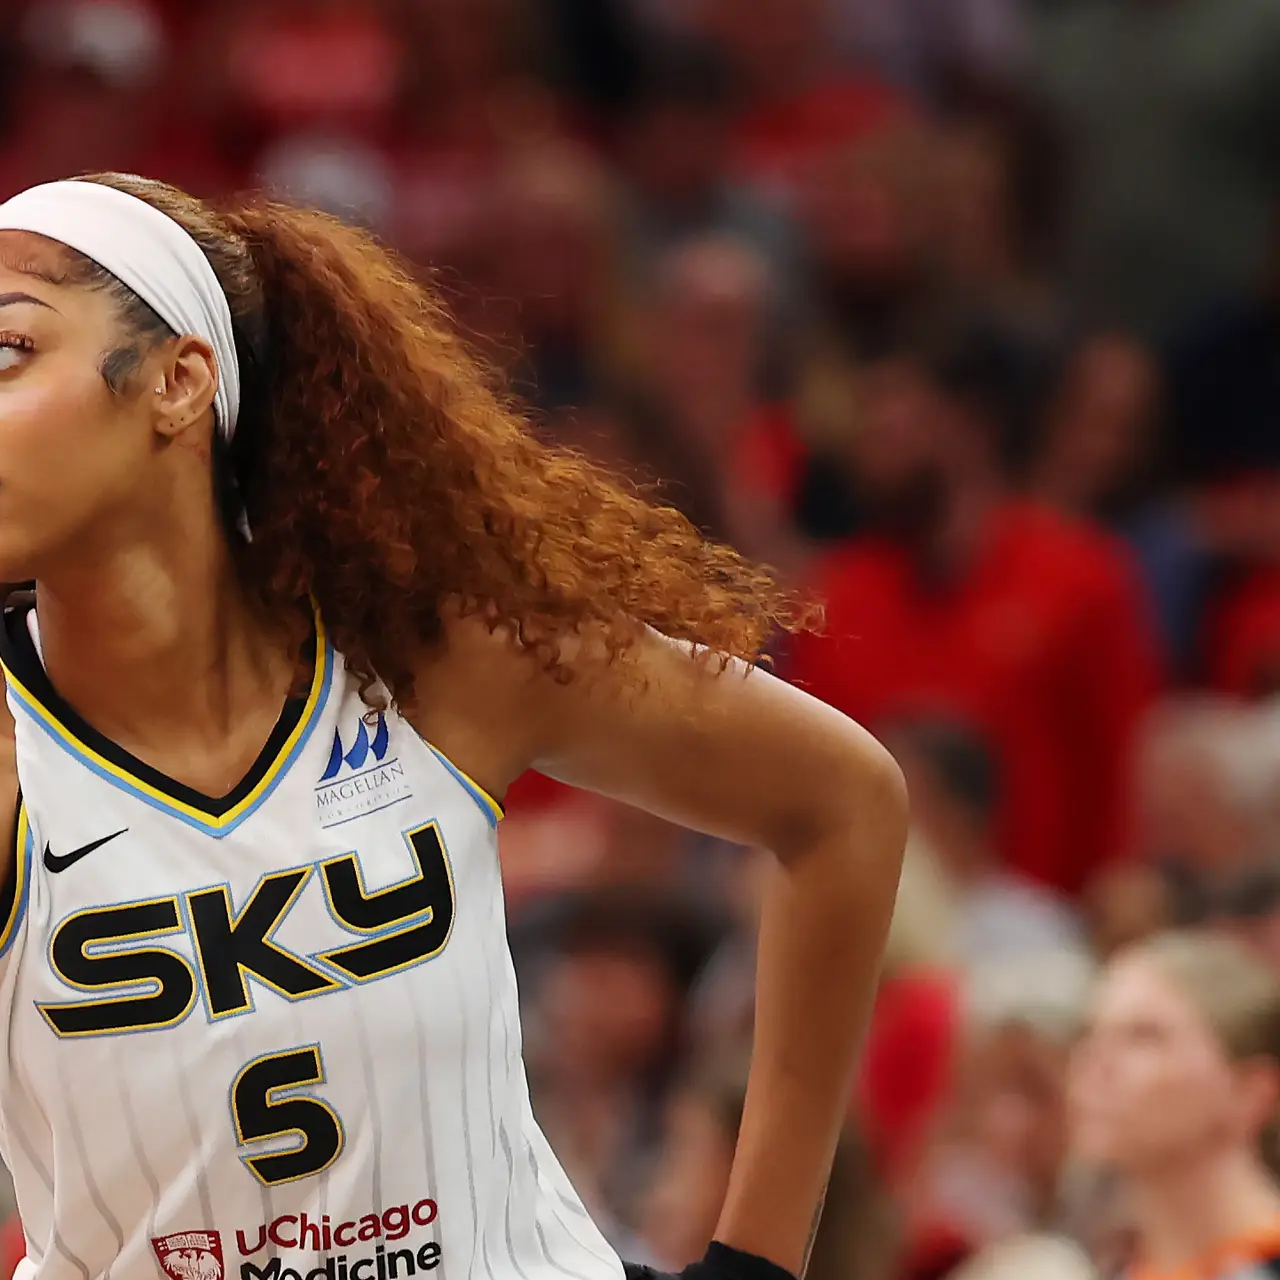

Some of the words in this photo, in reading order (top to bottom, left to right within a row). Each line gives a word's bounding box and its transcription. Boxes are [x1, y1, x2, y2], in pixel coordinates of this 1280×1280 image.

[316, 763, 404, 808] MAGELLAN
[34, 818, 456, 1039] SKY
[228, 1042, 346, 1188] 5
